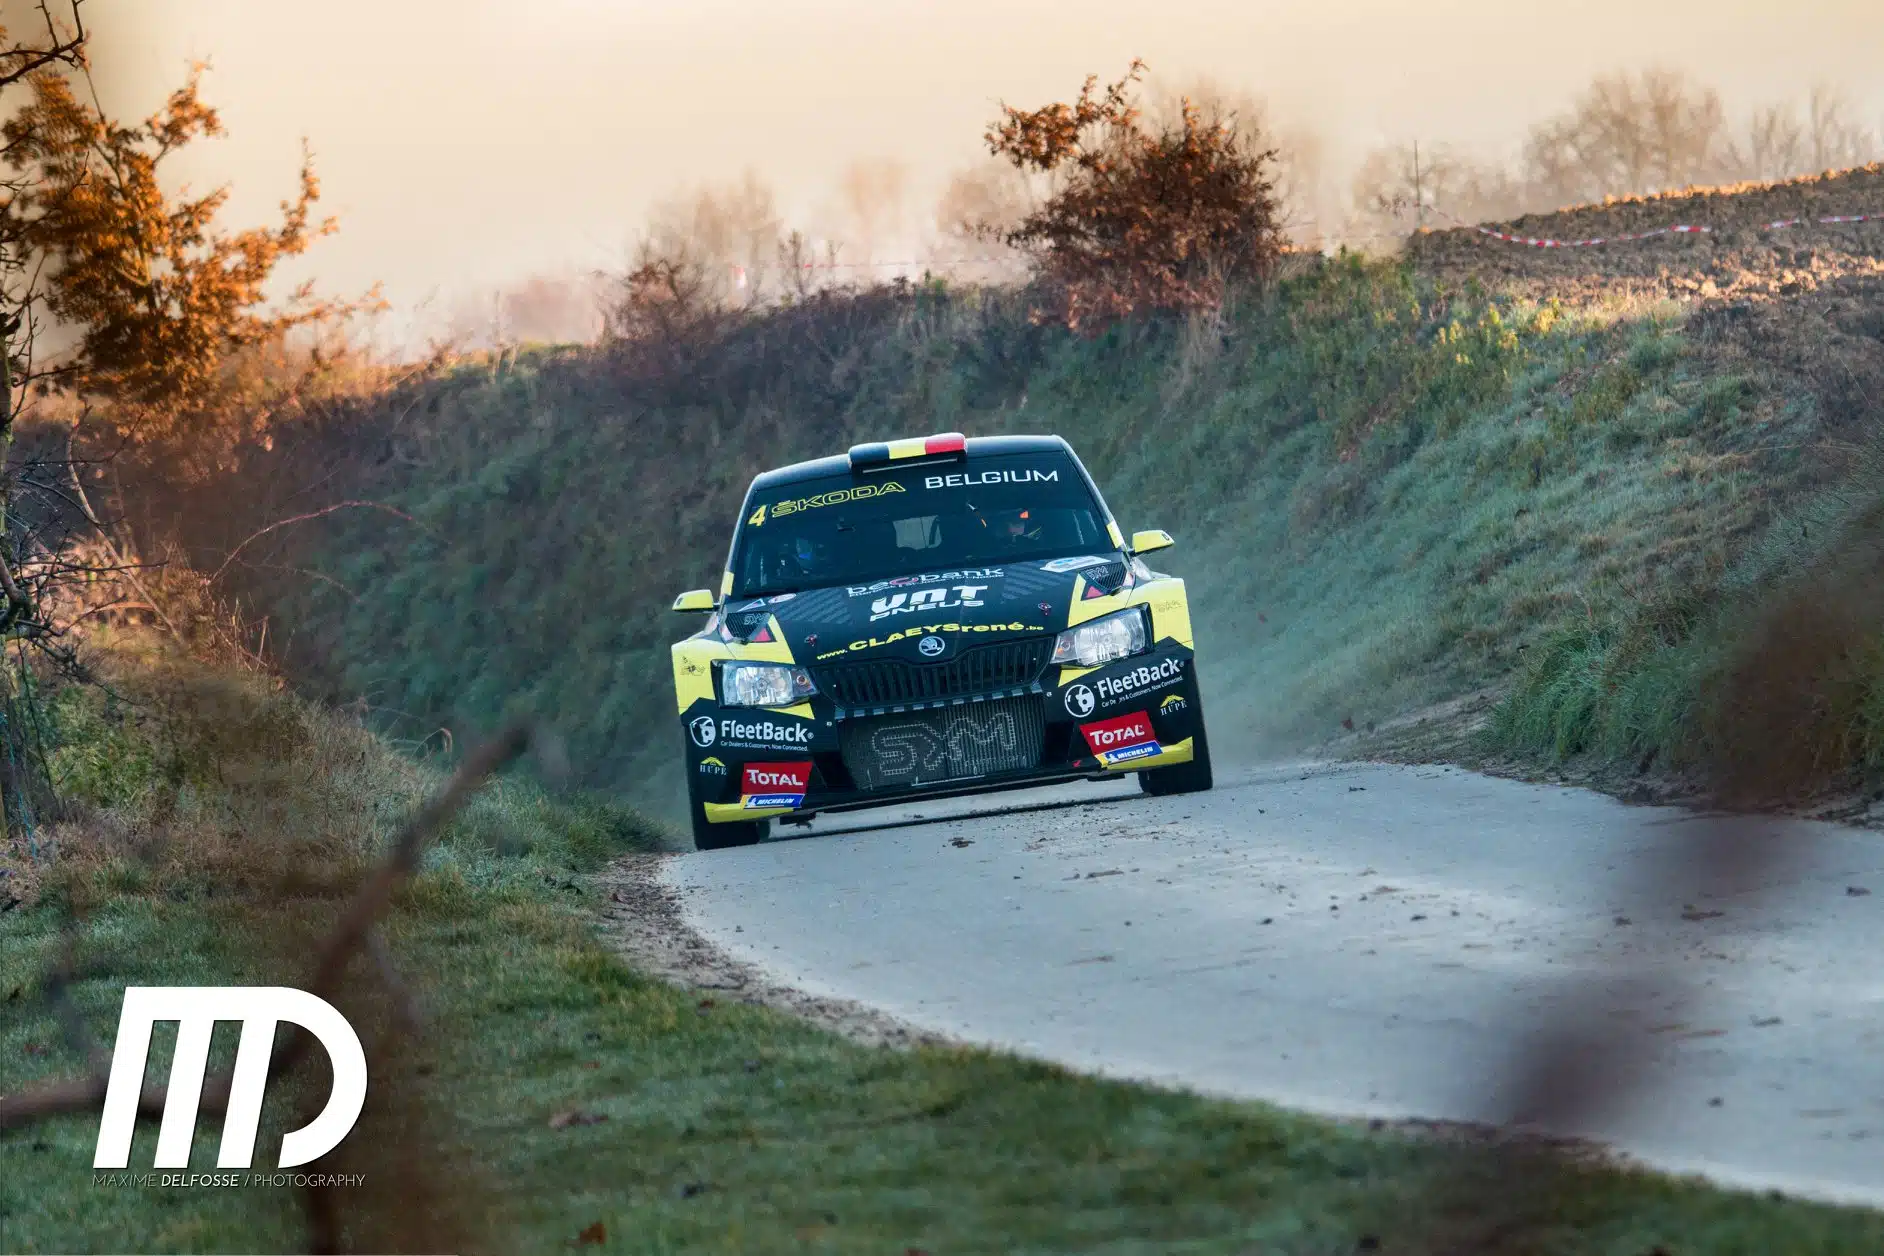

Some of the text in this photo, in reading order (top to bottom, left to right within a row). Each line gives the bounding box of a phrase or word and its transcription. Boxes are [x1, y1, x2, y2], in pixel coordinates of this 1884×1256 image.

[924, 470, 1059, 490] BELGIUM
[748, 504, 767, 527] 4
[869, 600, 984, 622] PNEUS
[1090, 724, 1145, 746] TOTAL
[1117, 746, 1153, 760] MICHELIN
[746, 769, 803, 786] TOTAL
[756, 797, 795, 805] MICHELIN
